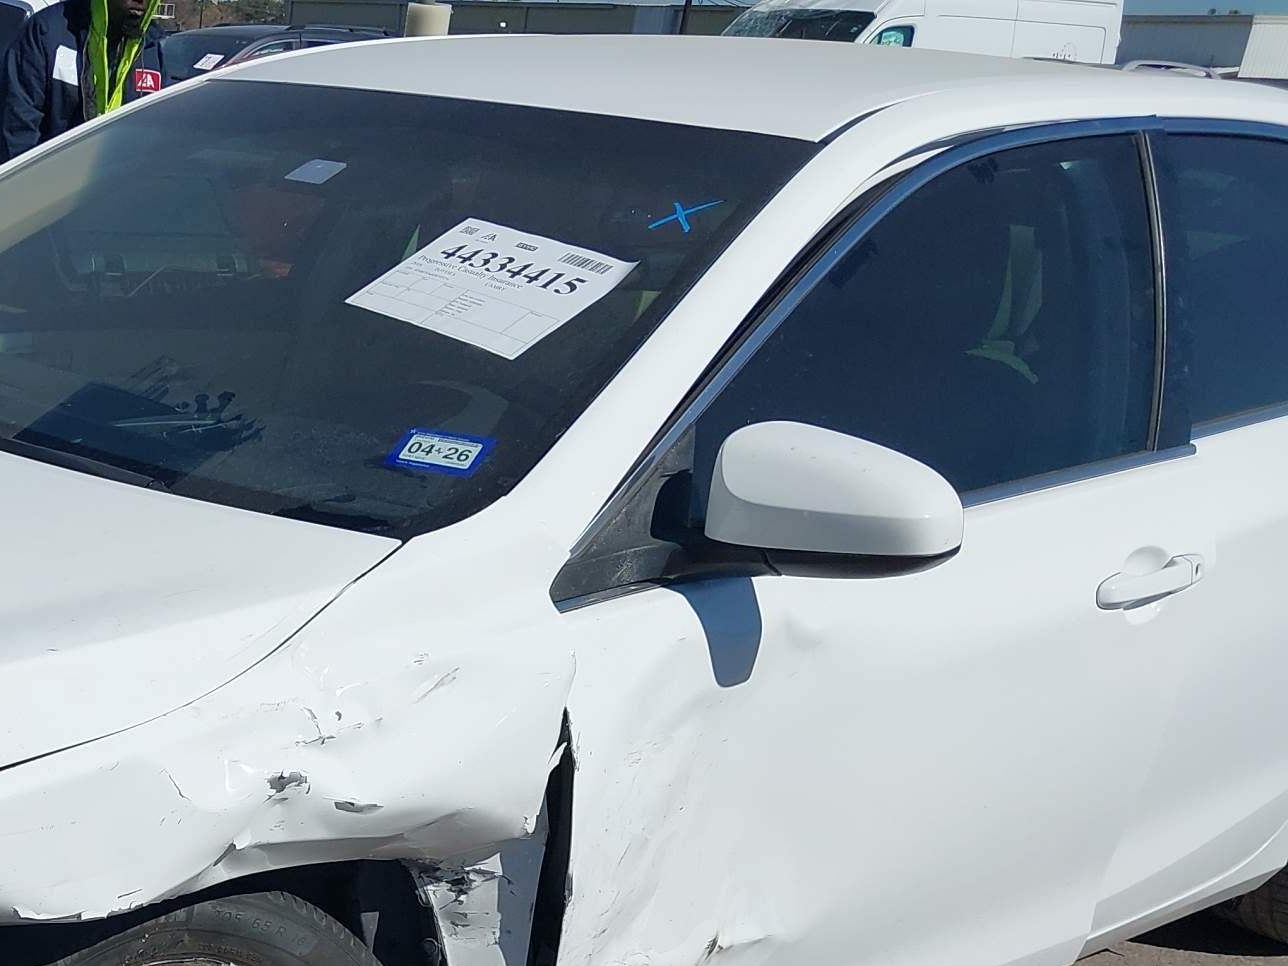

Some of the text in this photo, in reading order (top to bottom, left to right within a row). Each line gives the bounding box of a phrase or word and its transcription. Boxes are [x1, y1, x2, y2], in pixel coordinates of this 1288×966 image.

[417, 254, 458, 270] Progressive
[457, 265, 489, 280] Casualty
[487, 274, 524, 289] Insurance
[440, 244, 587, 294] 44334415
[407, 441, 473, 462] 04 26
